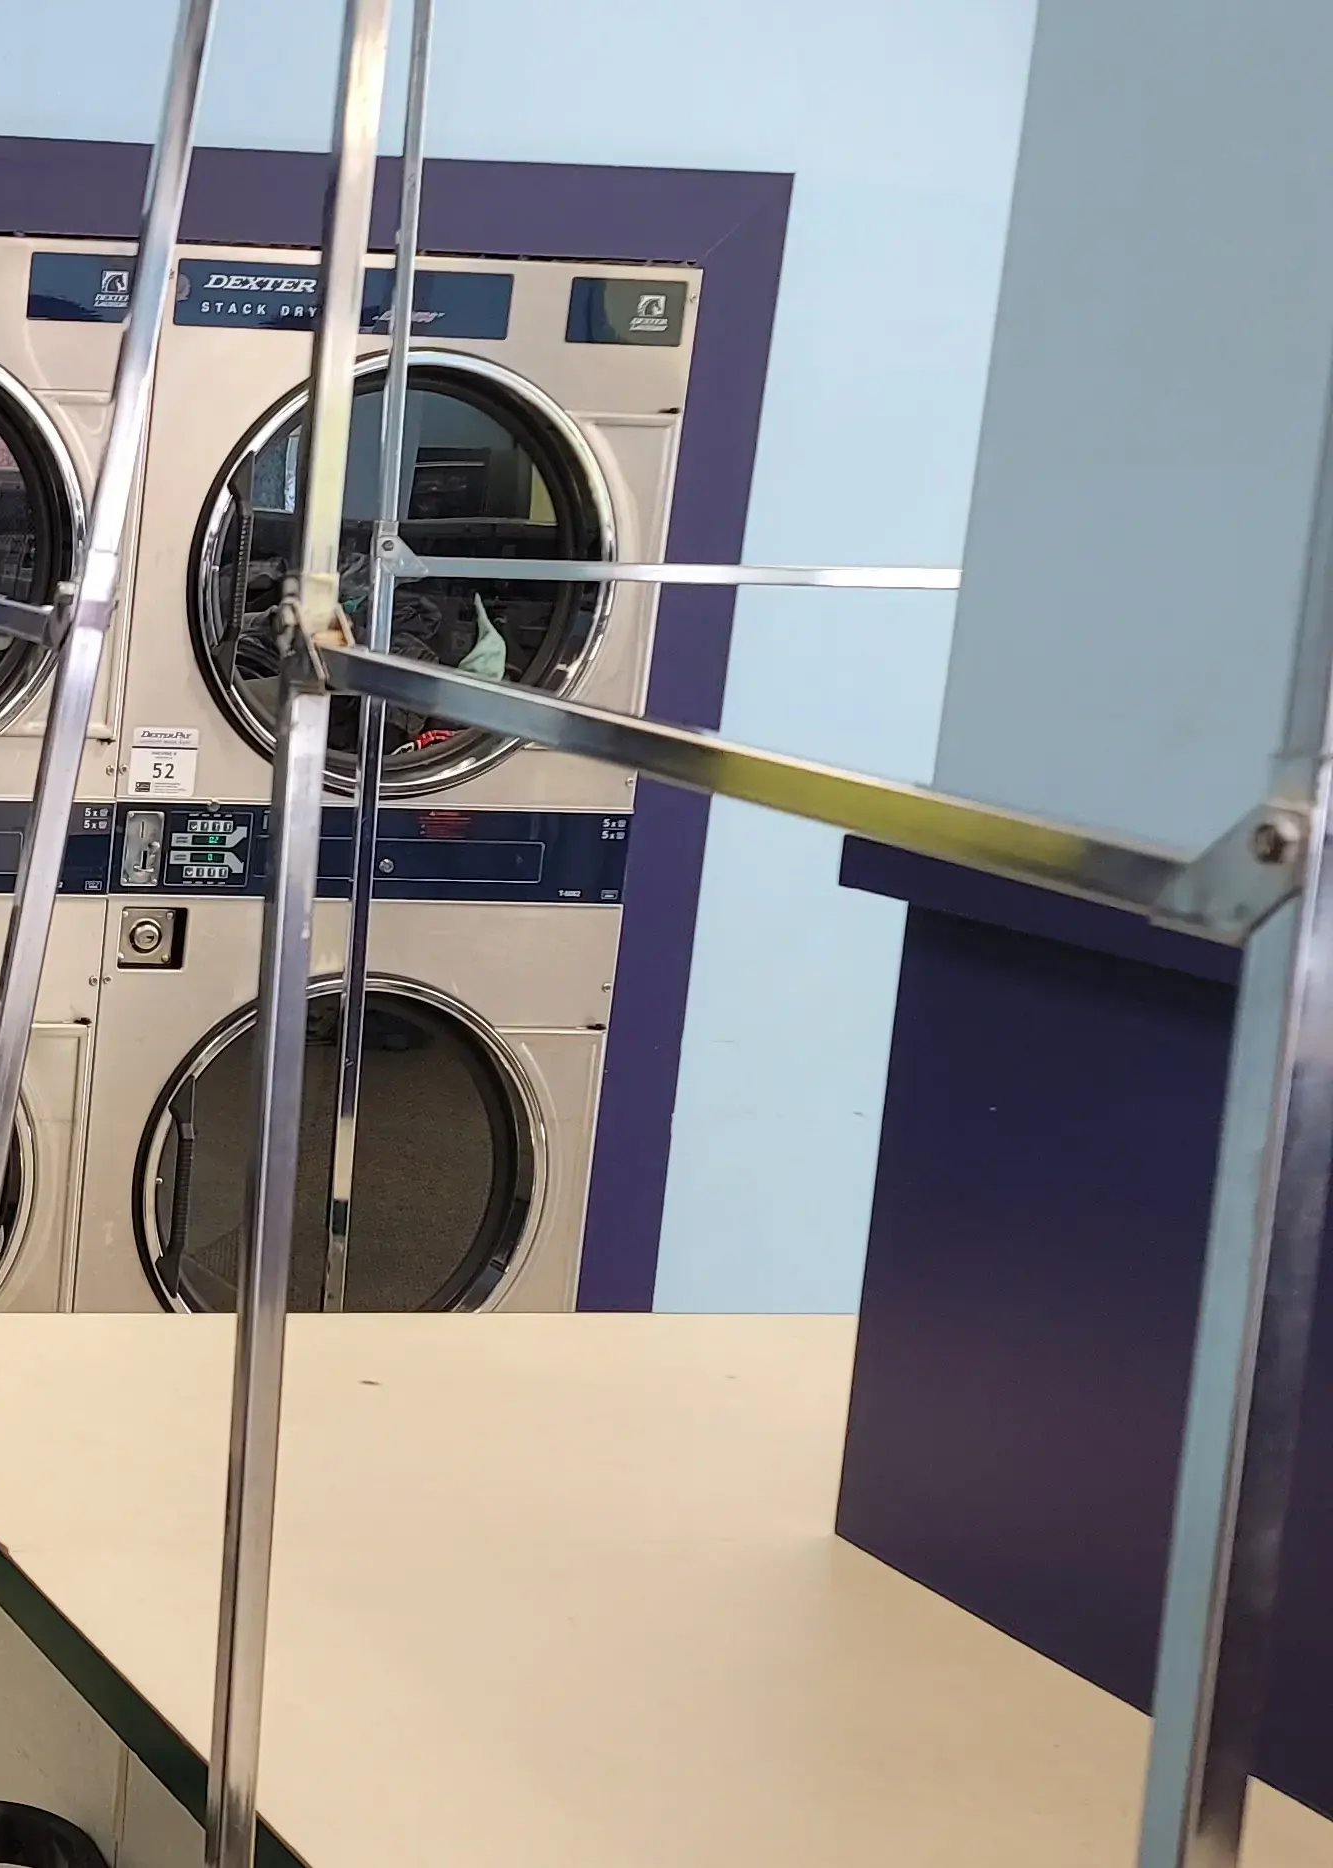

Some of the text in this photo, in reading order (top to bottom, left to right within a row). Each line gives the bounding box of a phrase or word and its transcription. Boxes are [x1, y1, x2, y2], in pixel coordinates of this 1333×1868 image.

[203, 274, 318, 293] DEXTER
[200, 301, 318, 318] STACK DRY
[152, 762, 175, 779] 52
[84, 807, 92, 817] 5
[83, 820, 91, 829] 5
[602, 818, 611, 828] 5
[601, 830, 610, 840] 5
